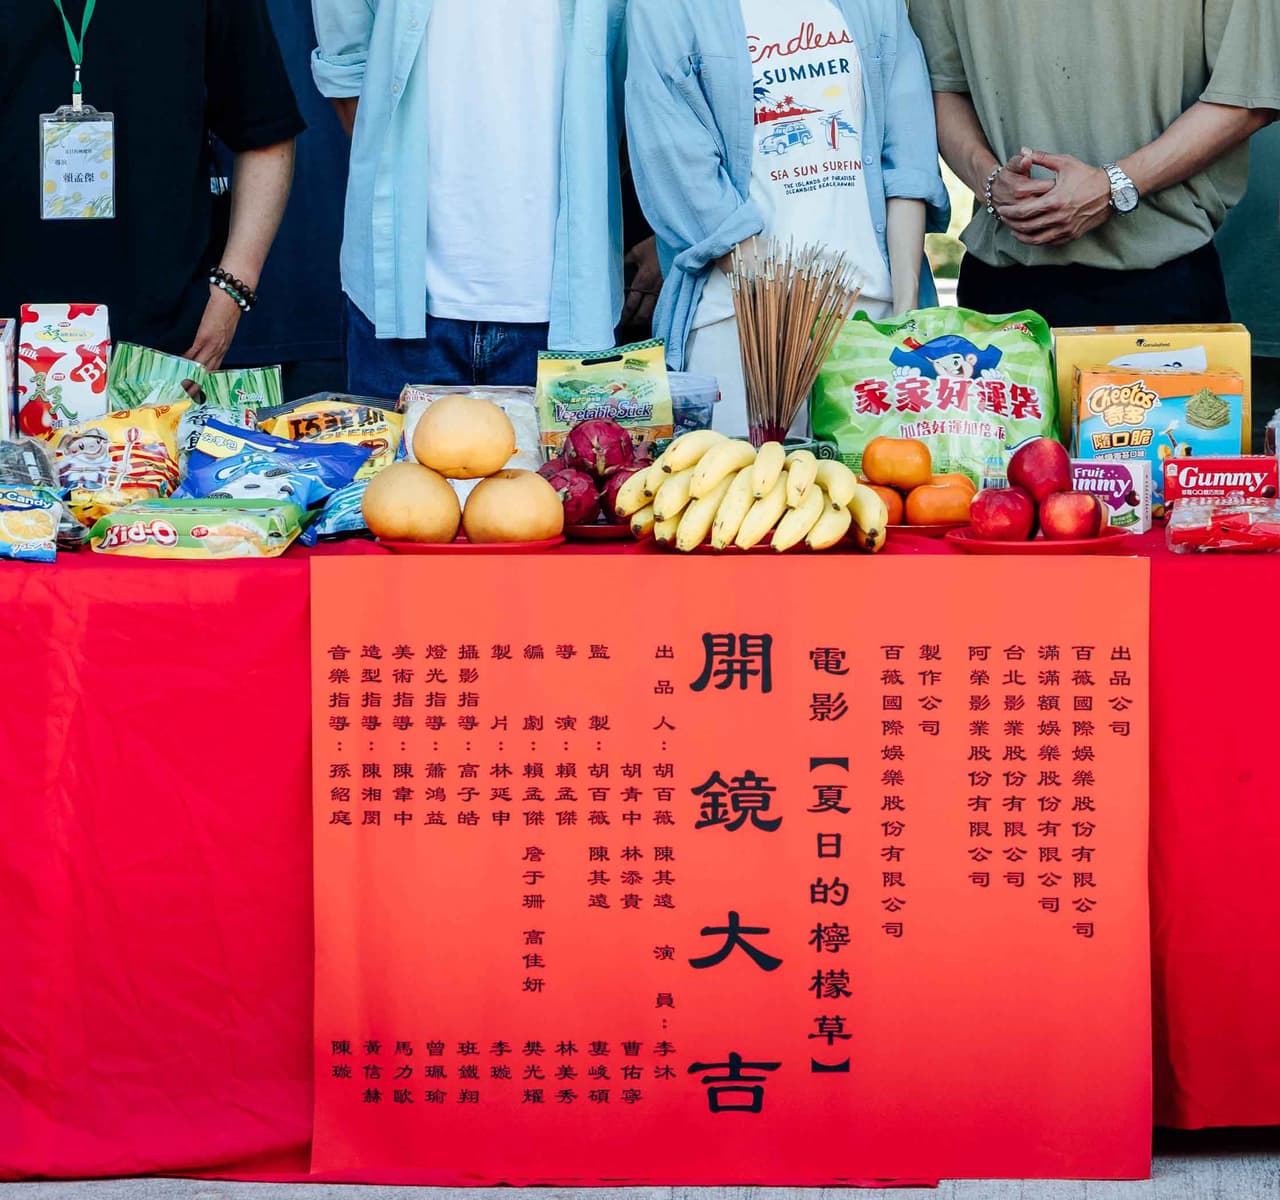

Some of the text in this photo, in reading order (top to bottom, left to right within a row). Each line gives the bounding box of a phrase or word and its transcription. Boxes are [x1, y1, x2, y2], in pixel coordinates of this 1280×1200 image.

[746, 22, 854, 64] Endless
[763, 58, 851, 86] SUMMER
[770, 169, 789, 181] SEA
[793, 164, 818, 177] SUN
[554, 399, 654, 422] Vegetable Stick
[852, 377, 1043, 421] 家家好運袋
[1089, 381, 1157, 413] Cheetos
[1103, 406, 1146, 427] 奇多
[200, 432, 238, 450] 分享包
[900, 419, 1007, 441] 加倍好運加倍乖
[1091, 429, 1155, 450] 隨口脆
[5, 491, 54, 508] Candy
[1073, 478, 1132, 498] mmy
[1074, 467, 1106, 480] Fruit
[1178, 467, 1269, 493] Gummy
[97, 519, 178, 549] Kid-O
[918, 644, 943, 736] 製作公司
[1108, 645, 1133, 737] 出品公司
[880, 645, 906, 938] 百薇國際娛樂股份有限公司
[967, 645, 993, 888] 阿榮影業股份有限公司
[1002, 644, 1027, 888] 台北影業股份有限公司
[1037, 644, 1062, 913] 滿滿額娛樂股份有限公司
[1071, 645, 1097, 939] 百薇國際娛樂股份有限公司
[620, 762, 645, 909] 胡青中 林添貴
[807, 647, 853, 1074] 電影【夏日的檸檬草】
[522, 846, 545, 909] 詹于珊
[587, 846, 611, 909] 陳其遠
[652, 846, 677, 909] 陳其遠
[686, 632, 784, 1115] 開鏡大吉
[522, 929, 545, 993] 高佳妍
[330, 1039, 353, 1079] 陳璇
[393, 1040, 414, 1105] 馬力歐
[424, 1040, 448, 1104] 曾珮瑜
[456, 1040, 481, 1104] 班鐵翔
[490, 1040, 513, 1080] 李璇
[521, 1040, 546, 1104] 樊光耀
[554, 1040, 579, 1105] 林美秀
[588, 1040, 611, 1104] 婁峻碩
[621, 1040, 644, 1105] 曹佑寧
[653, 1040, 677, 1081] 李沐
